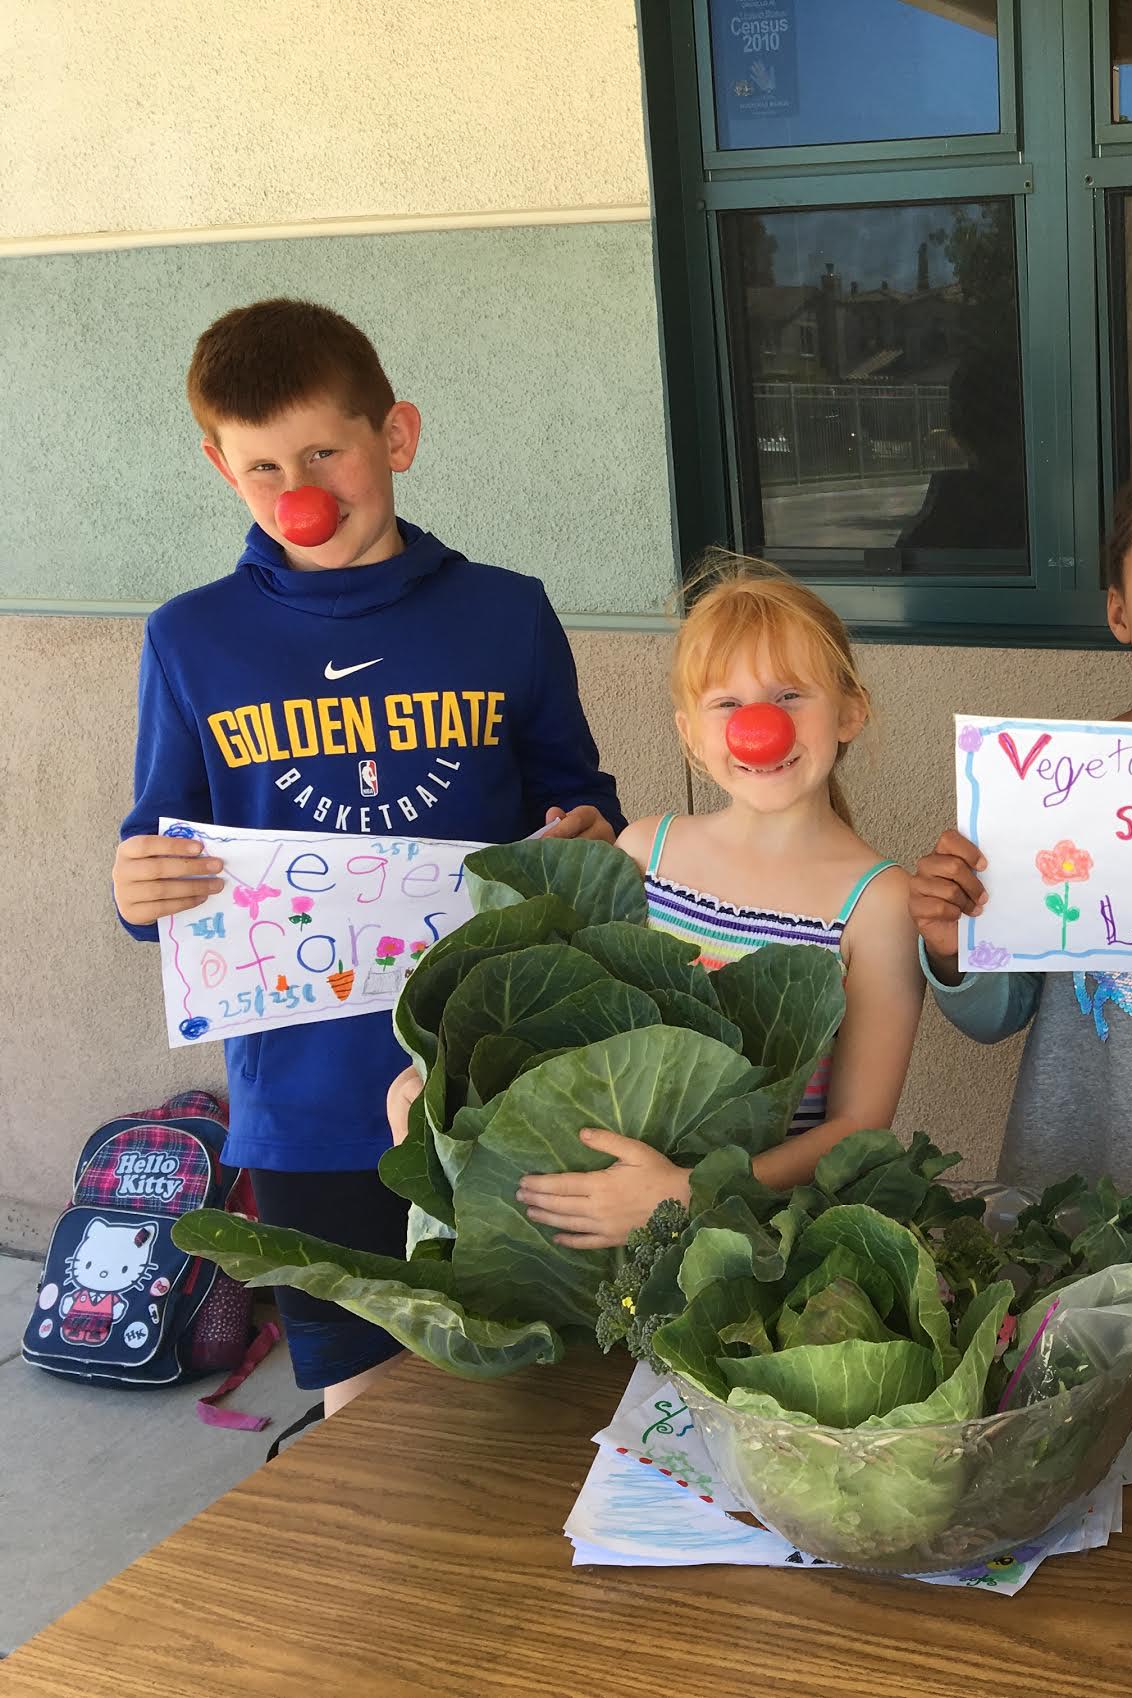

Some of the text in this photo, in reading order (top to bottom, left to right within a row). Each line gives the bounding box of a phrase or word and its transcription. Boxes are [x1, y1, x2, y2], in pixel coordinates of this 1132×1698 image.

[731, 17, 788, 36] Census
[743, 33, 779, 52] 2010
[207, 691, 505, 768] GOLDEN STATE
[274, 757, 461, 832] BASKETBALL
[235, 920, 381, 991] for
[116, 1154, 176, 1174] Hello
[119, 1174, 182, 1199] Kitty
[125, 1328, 147, 1343] HK
